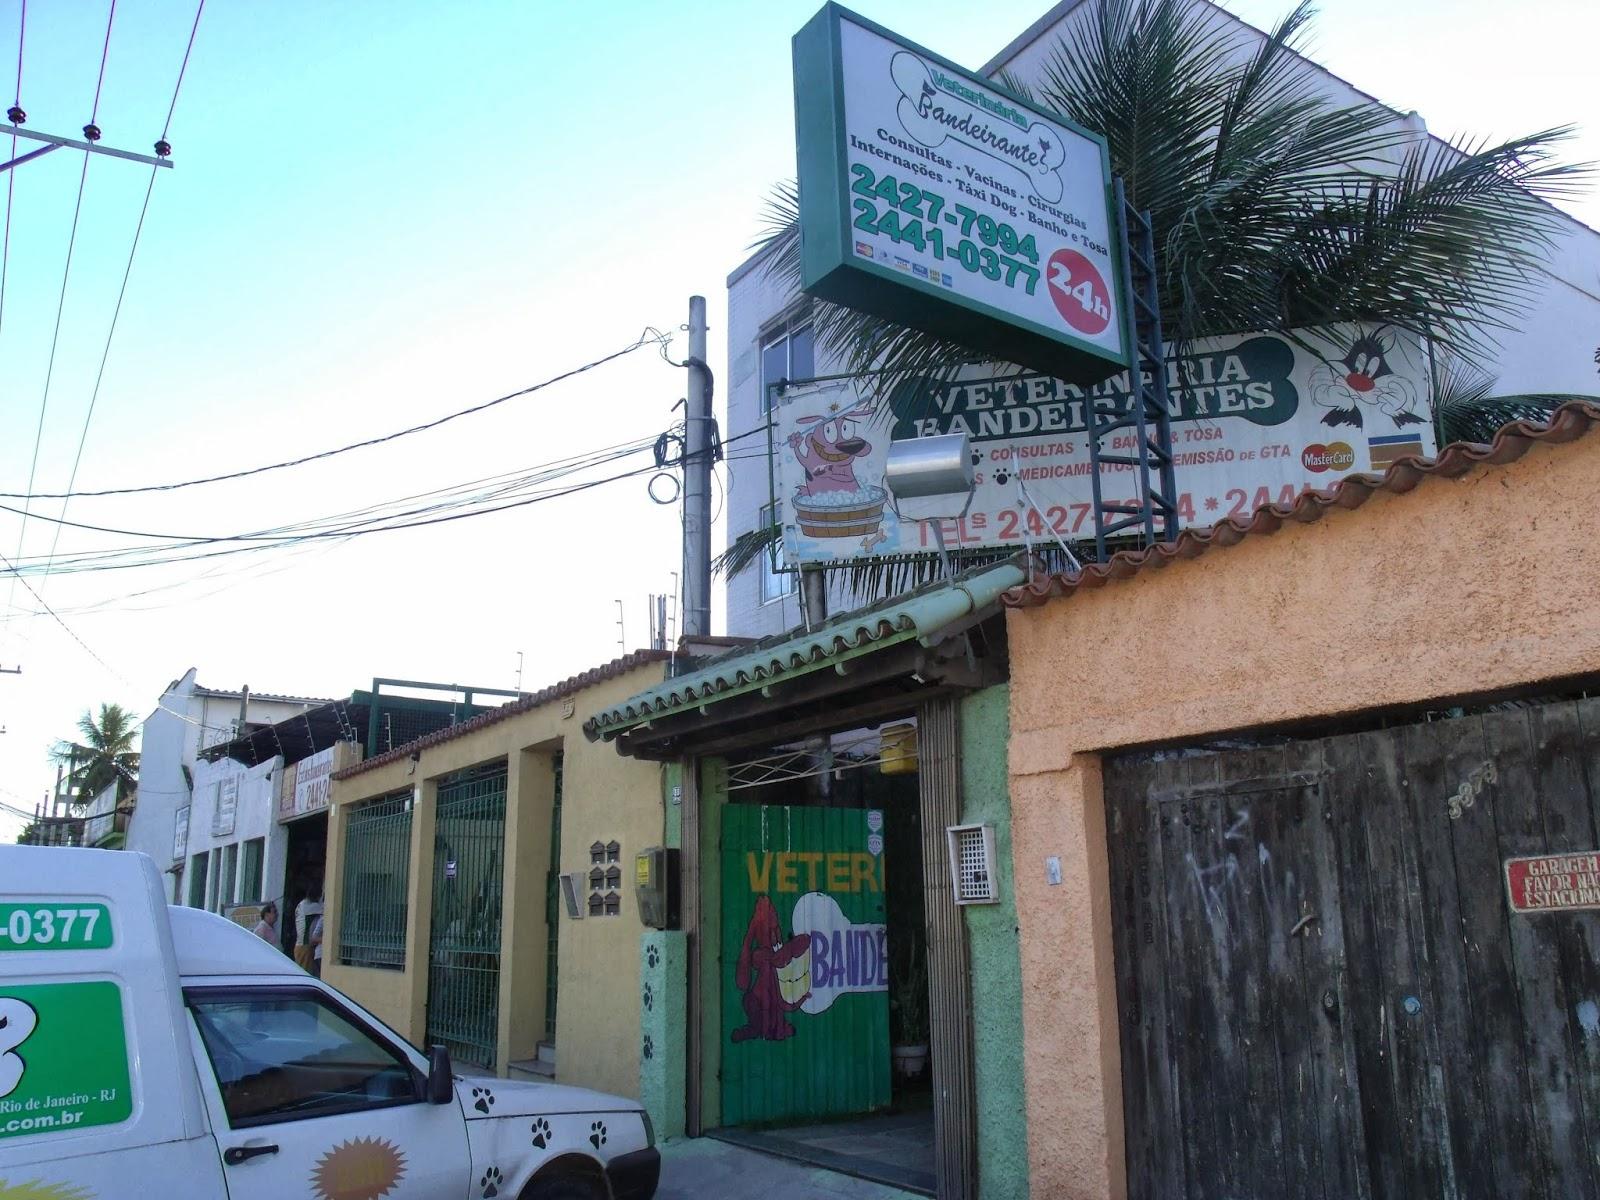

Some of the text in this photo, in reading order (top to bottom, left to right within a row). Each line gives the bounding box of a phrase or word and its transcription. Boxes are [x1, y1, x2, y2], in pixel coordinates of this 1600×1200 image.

[877, 128, 953, 170] Consultas
[964, 164, 1017, 198] Vacinas
[1027, 195, 1087, 230] Cirurgias
[850, 134, 943, 183] Internações
[990, 193, 1017, 217] Dog
[1027, 210, 1068, 238] Banho
[1071, 233, 1078, 242] e
[1081, 234, 1108, 256] Tosa
[850, 163, 1040, 265] 2427-7994
[853, 198, 1041, 296] 2441-0377
[1049, 261, 1110, 321] 24h
[1184, 427, 1223, 442] TOSA
[990, 442, 1075, 461] CONSULTAS
[1171, 449, 1235, 466] EMISSÃO
[1260, 445, 1291, 460] GTA
[1304, 451, 1353, 467] MasterCard
[998, 493, 1196, 539] 2427-74
[1528, 856, 1599, 876] GARAGEM
[1524, 874, 1572, 892] FAVOR
[0, 1101, 22, 1113] Rio
[25, 1098, 40, 1111] de
[43, 1093, 89, 1108] Janeiro
[100, 1088, 116, 1102] RJ
